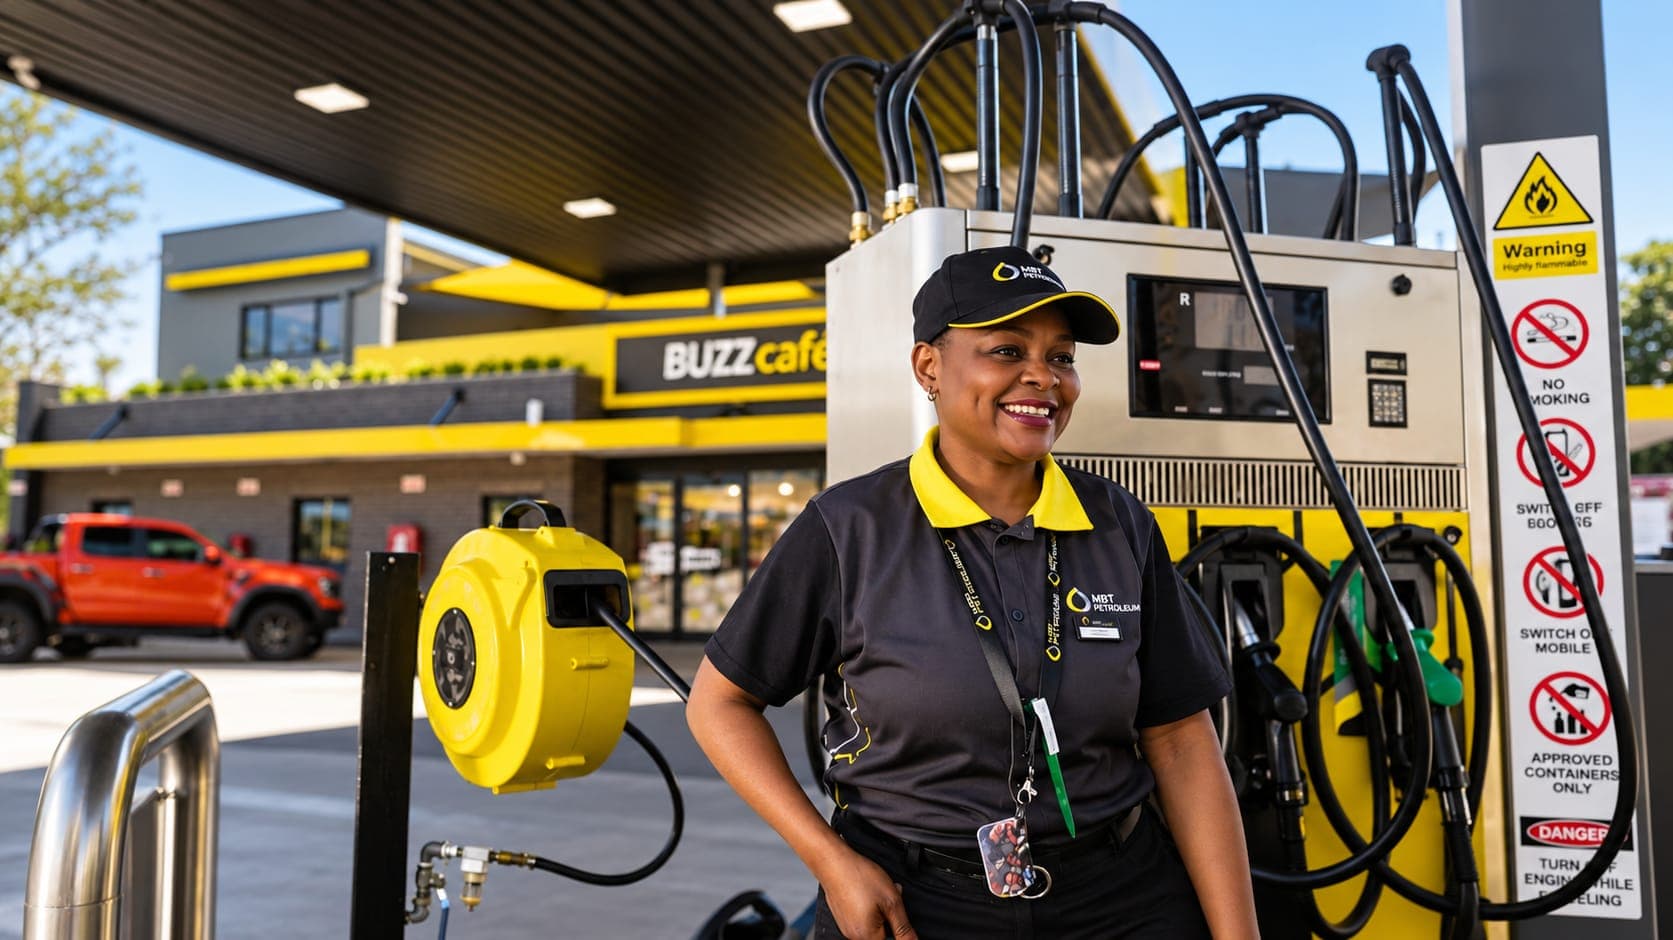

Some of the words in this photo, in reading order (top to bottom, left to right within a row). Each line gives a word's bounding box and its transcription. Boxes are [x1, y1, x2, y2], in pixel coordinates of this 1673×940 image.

[1503, 240, 1586, 259] Warning
[1503, 260, 1533, 272] Highly
[1535, 258, 1587, 270] flammable
[1179, 292, 1191, 306] R
[1543, 378, 1565, 390] NO
[1530, 392, 1590, 406] MOKING
[1516, 503, 1552, 515] SWIT
[1091, 594, 1114, 604] MBT
[1093, 603, 1141, 612] PETROLEUM
[1520, 628, 1576, 640] SWITCH
[1535, 642, 1591, 654] MOBILE
[1531, 752, 1613, 767] APPROVED
[1524, 766, 1619, 781] CONTAINERS
[1552, 782, 1592, 794] ONLY
[1539, 858, 1580, 871] TURN
[1525, 873, 1572, 886] ENGIN
